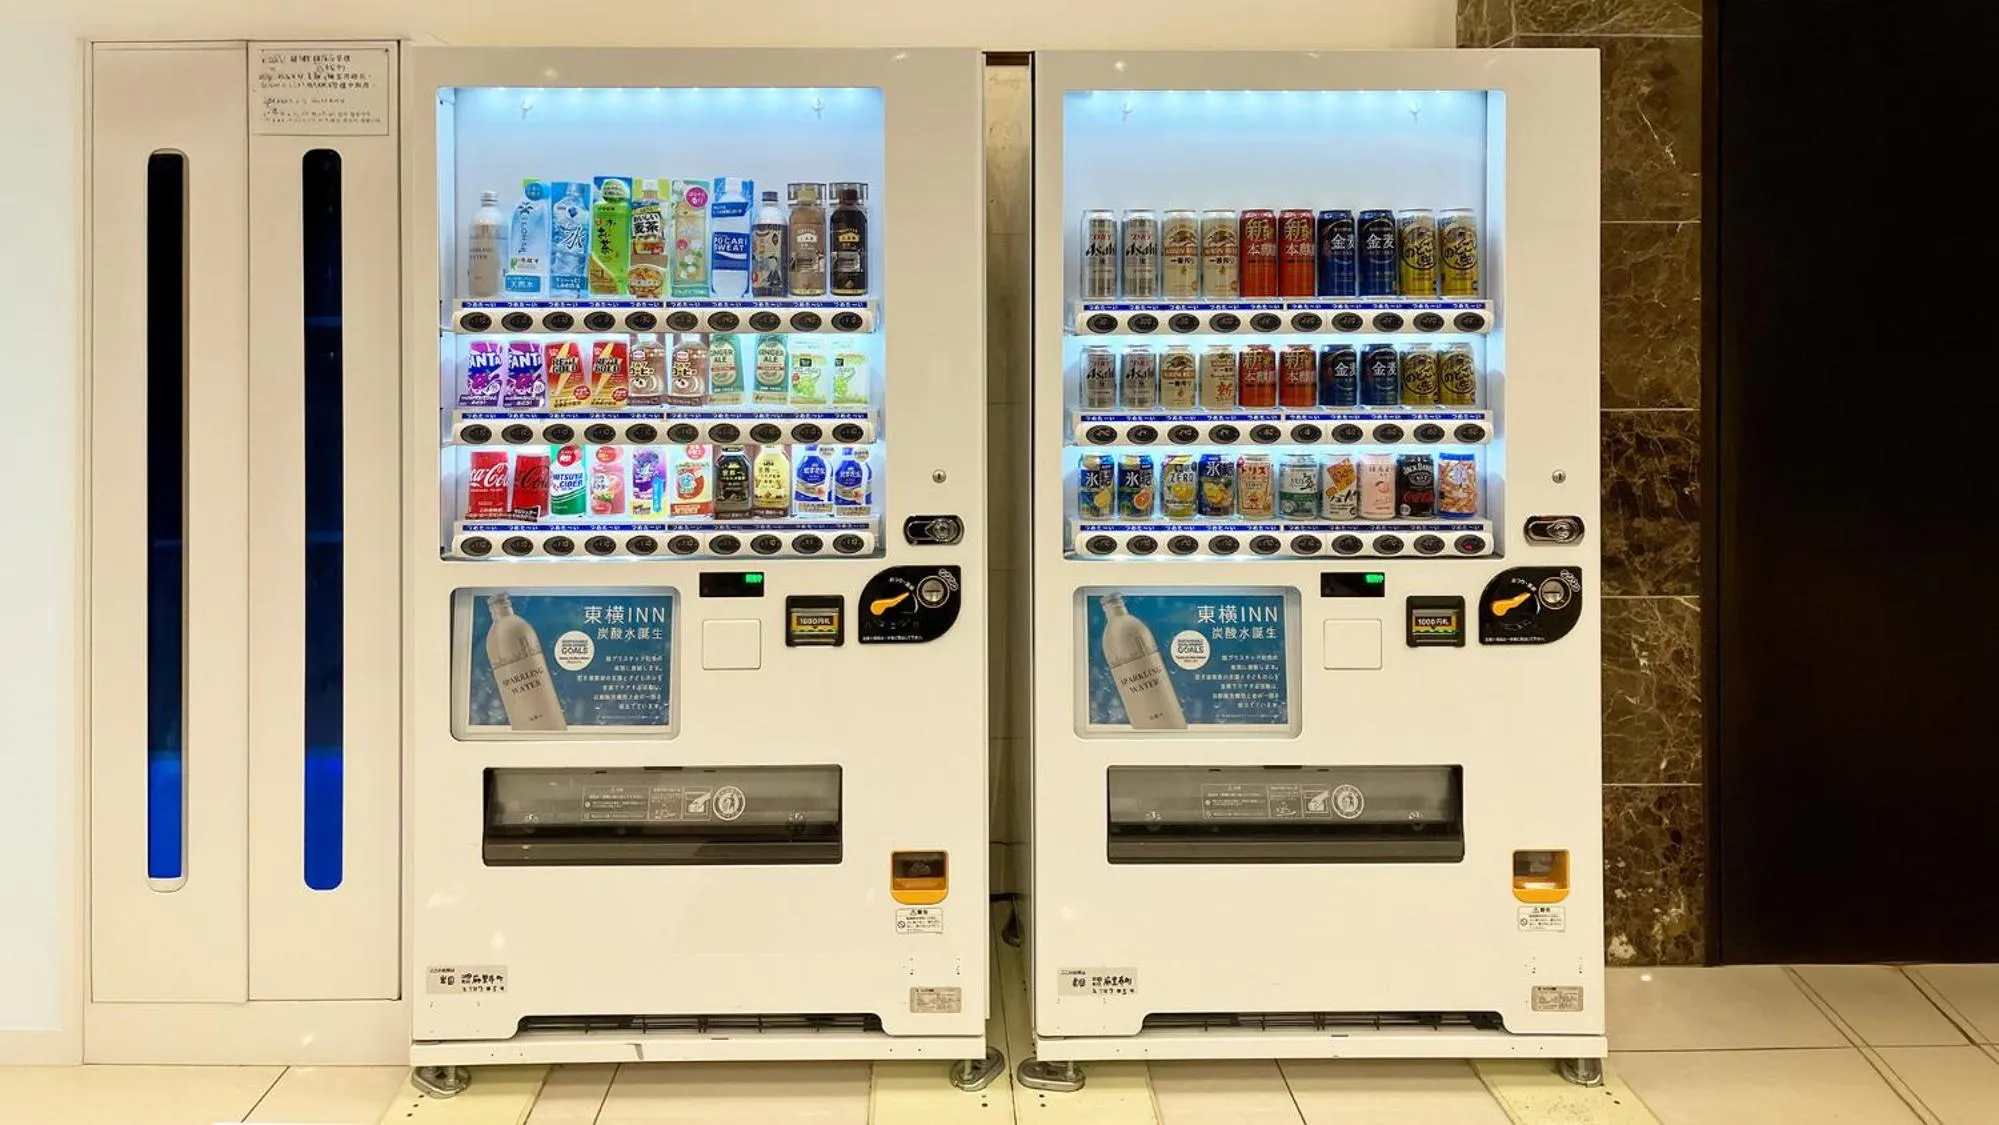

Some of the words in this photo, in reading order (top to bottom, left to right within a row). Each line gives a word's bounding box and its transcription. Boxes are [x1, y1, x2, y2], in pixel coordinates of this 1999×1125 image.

[634, 222, 659, 234] 麦茶
[714, 237, 747, 245] POCARI
[714, 244, 745, 252] SWEAT
[1366, 233, 1395, 250] 金麦
[1371, 361, 1397, 377] 金麦
[1170, 472, 1194, 482] ZERO
[584, 605, 665, 624] 東横INN
[1197, 604, 1278, 624] 東横INN
[597, 627, 663, 641] 炭酸水誕生
[1211, 627, 1277, 640] 炭酸水誕生
[561, 646, 589, 655] GOALS
[502, 666, 544, 687] SPARKLING
[1120, 665, 1162, 686] SPARKLING
[511, 679, 542, 696] WATER
[1129, 678, 1161, 694] WATER
